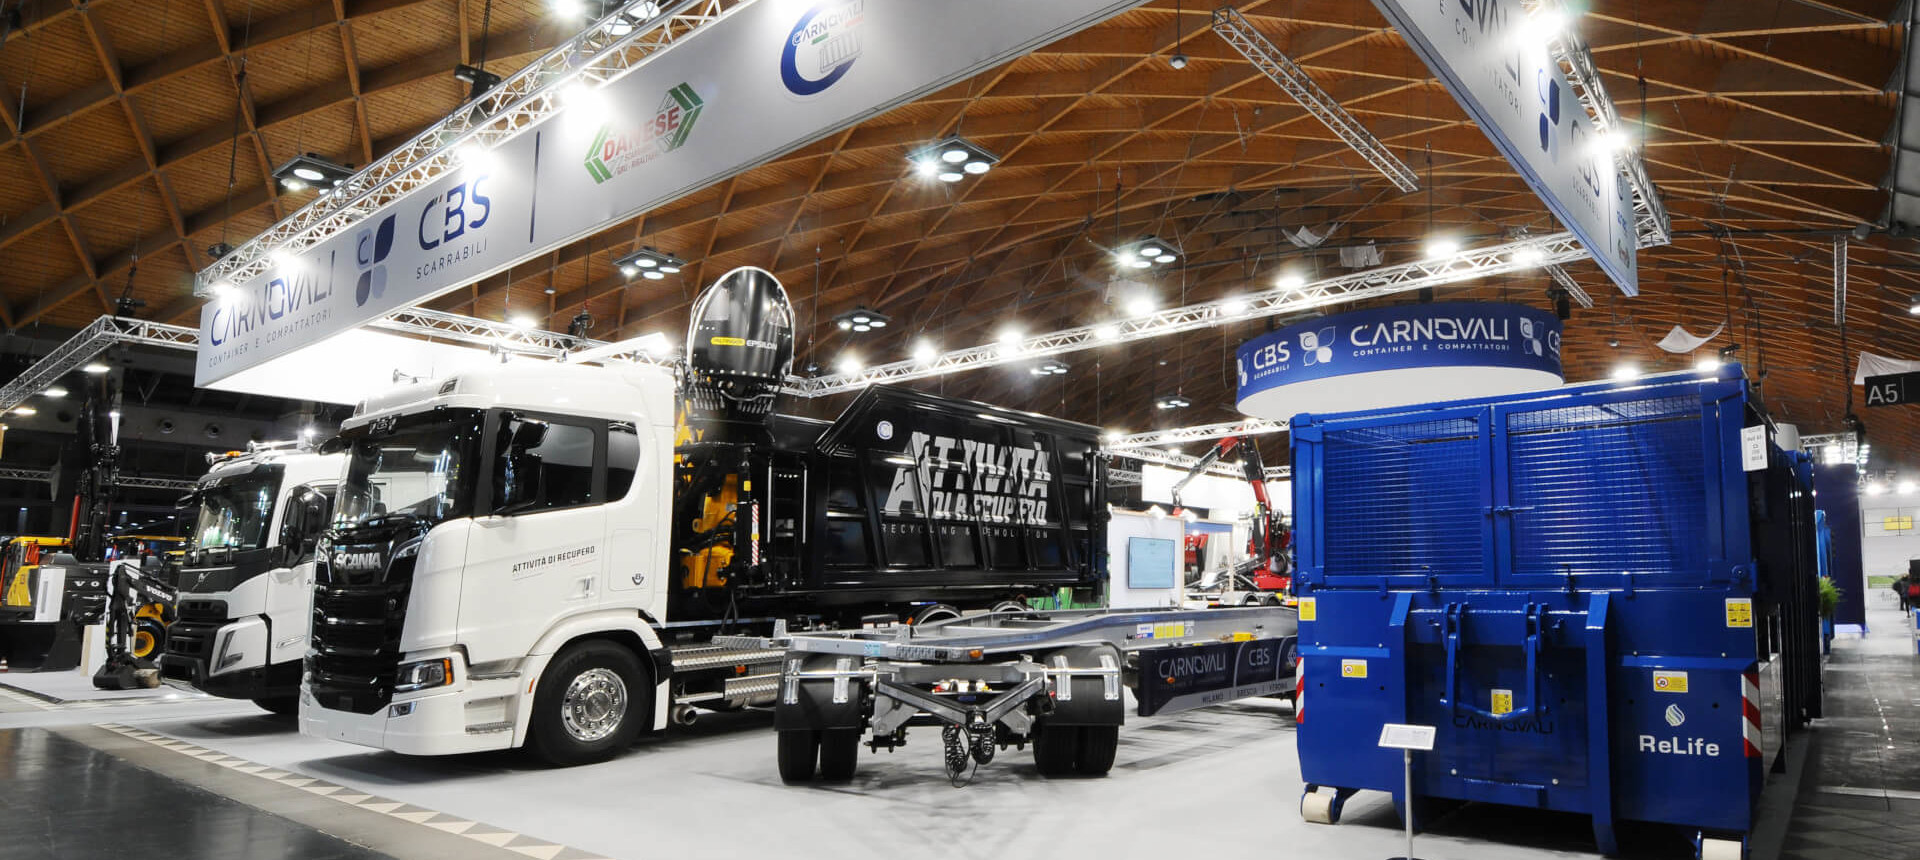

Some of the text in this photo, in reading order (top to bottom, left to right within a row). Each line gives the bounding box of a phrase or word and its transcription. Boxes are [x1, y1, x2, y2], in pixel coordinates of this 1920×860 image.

[604, 106, 680, 161] DANESE
[419, 175, 491, 251] CBS
[416, 239, 488, 280] SCARRABILI
[210, 250, 336, 347] CARNOVALI
[209, 309, 333, 369] CONTAINER E COMPATTATORI
[746, 340, 777, 351] EPSILON
[1350, 318, 1508, 347] CARNOVALI
[1254, 341, 1290, 370] CBS
[1353, 345, 1412, 357] CONTAINER
[1438, 343, 1510, 351] COMPATTATORI
[1868, 384, 1898, 405] A5
[881, 522, 956, 536] RECYCLNG
[982, 526, 1048, 539] DEMOLTON
[335, 552, 382, 570] SCANIA
[512, 545, 595, 573] ATTIVITÀ DI RECUPERO
[145, 585, 173, 601] VOLVO
[1158, 648, 1270, 679] CARNOVALI CBS
[1453, 714, 1553, 735] CARNOVALI
[1639, 735, 1720, 757] ReLife
